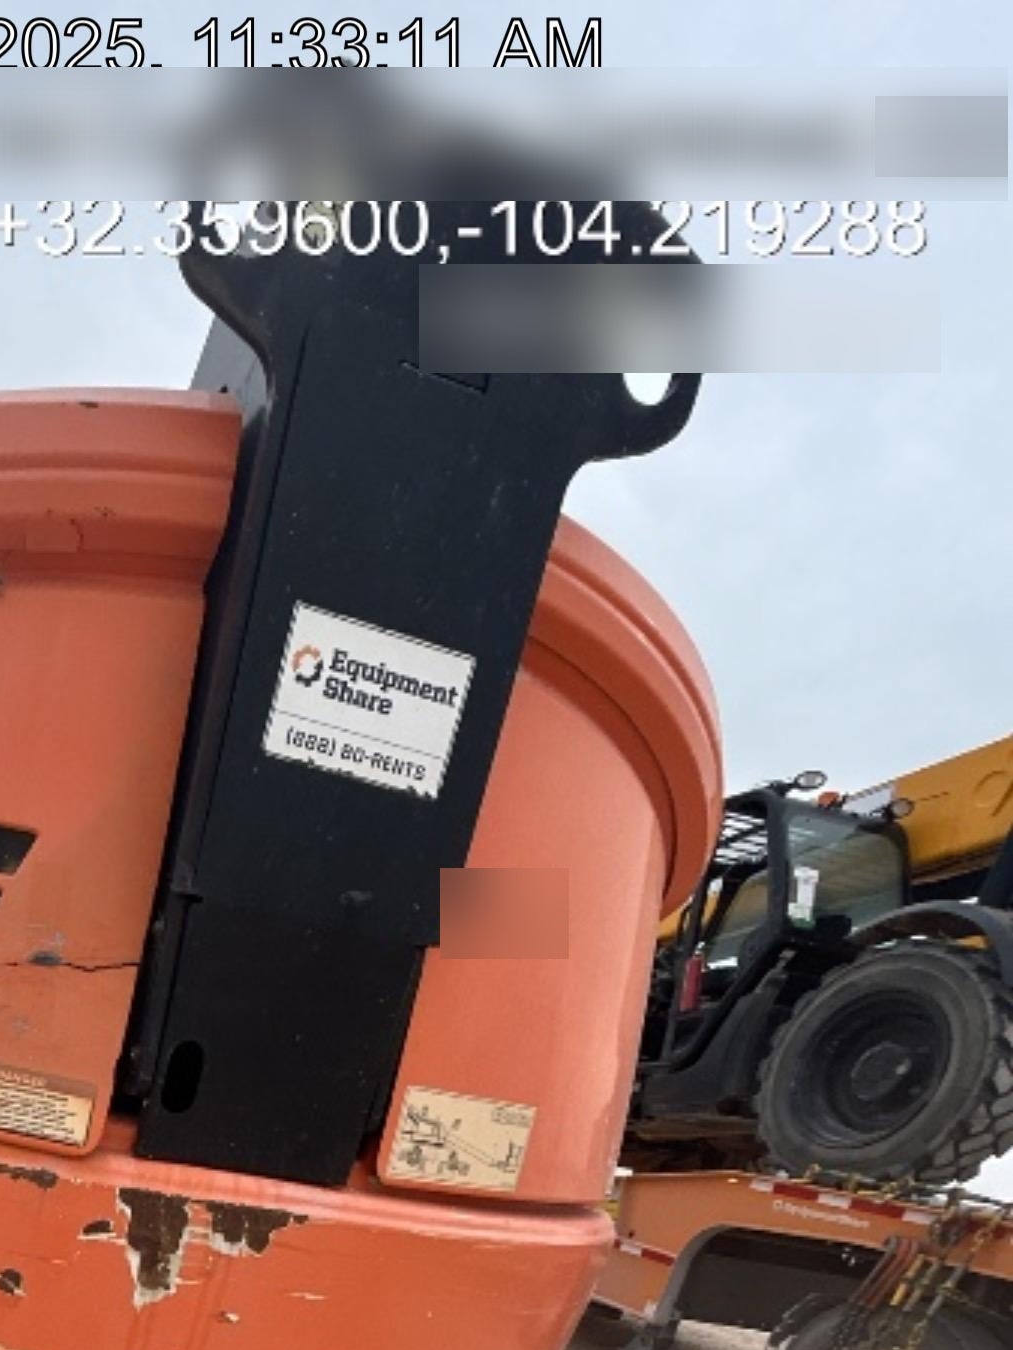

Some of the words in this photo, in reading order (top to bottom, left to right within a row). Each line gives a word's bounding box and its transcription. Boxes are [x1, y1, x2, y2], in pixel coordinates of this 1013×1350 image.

[322, 676, 393, 715] Share
[329, 649, 458, 707] Equipment
[286, 726, 337, 757] (888)
